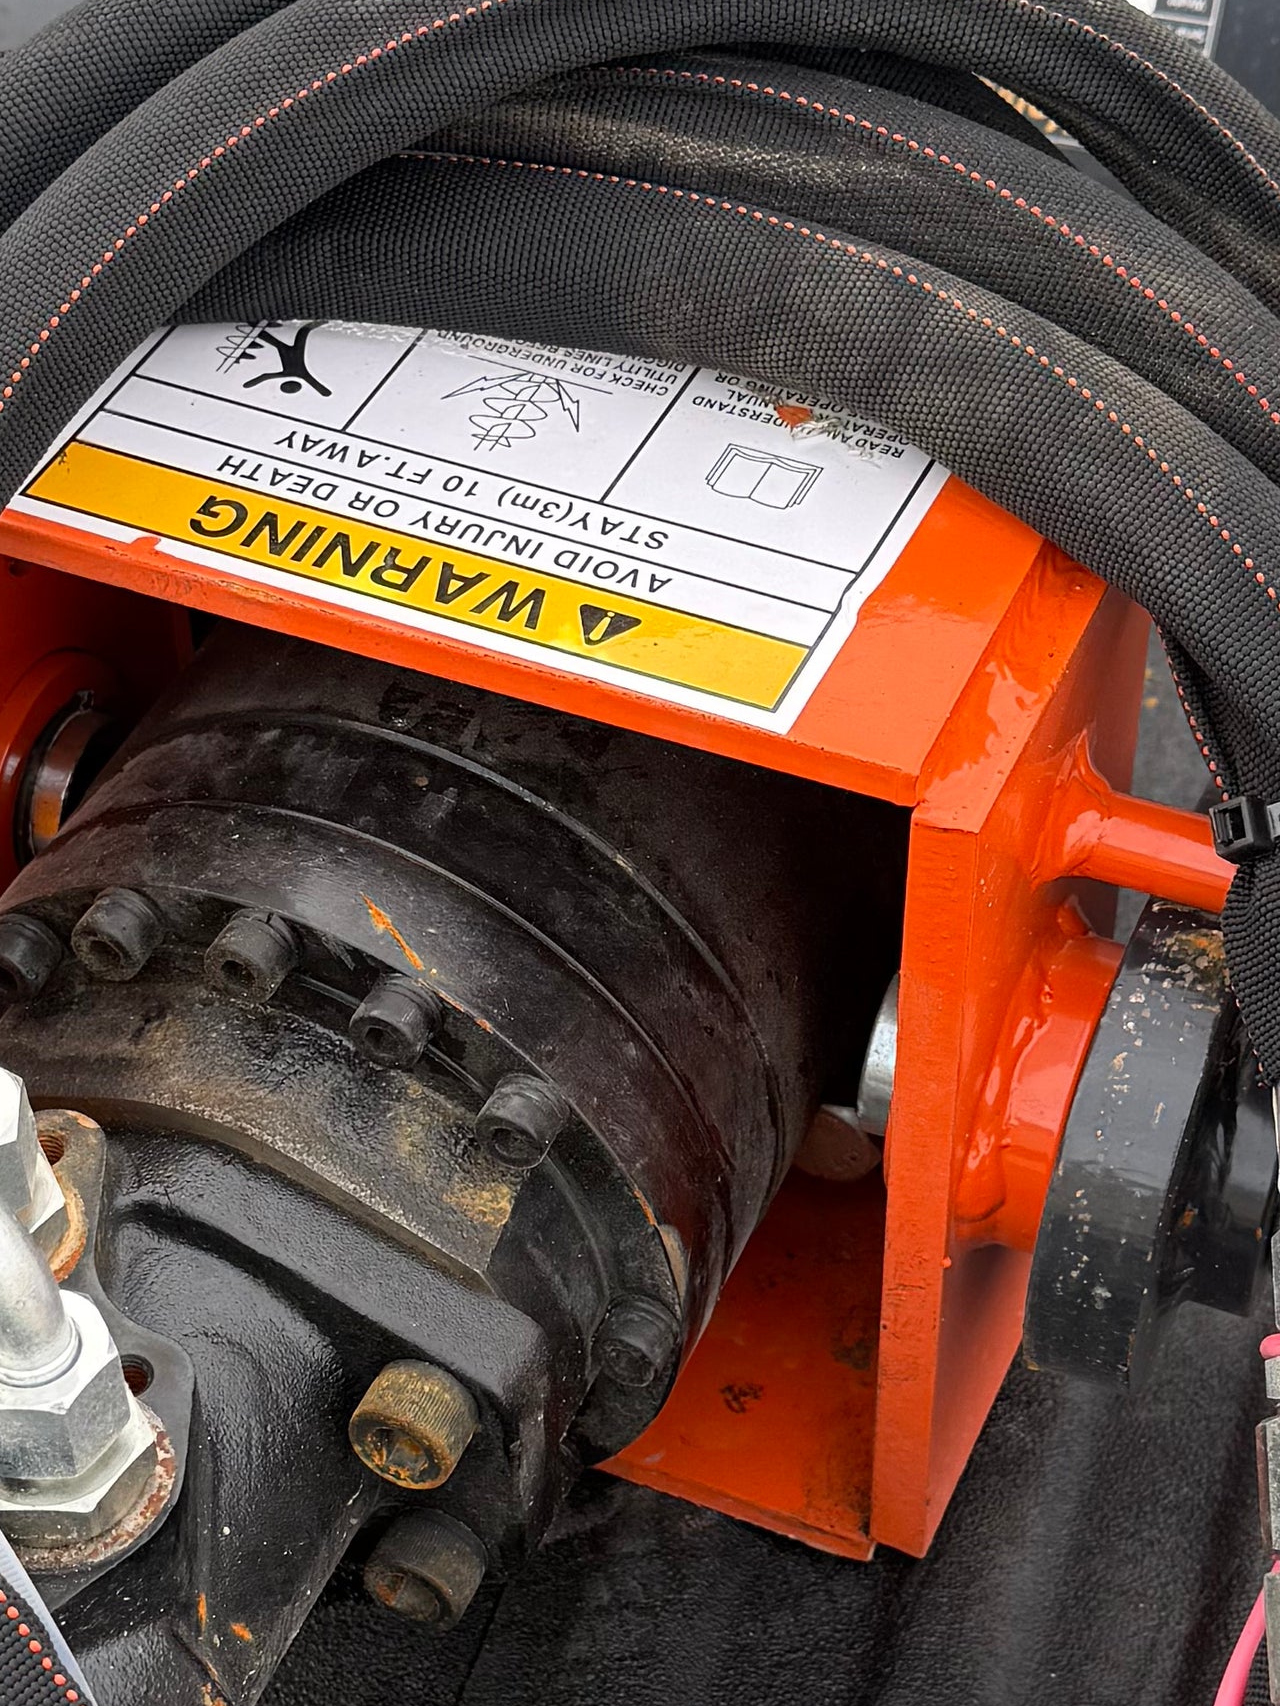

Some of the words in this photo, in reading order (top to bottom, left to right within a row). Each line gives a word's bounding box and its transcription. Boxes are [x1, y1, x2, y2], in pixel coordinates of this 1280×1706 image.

[563, 347, 613, 369] LINES
[571, 362, 608, 381] FOR
[613, 362, 679, 385] UTILITY
[714, 371, 742, 387] OR
[606, 374, 670, 397] CHECK
[855, 436, 906, 459] READ
[217, 454, 340, 504] DEATH
[441, 474, 480, 498] 10
[347, 490, 400, 519] OR
[497, 490, 669, 551] STAY(3m)
[410, 509, 542, 559] INJURY
[189, 494, 547, 631] WARNING
[553, 548, 673, 594] AVOID
